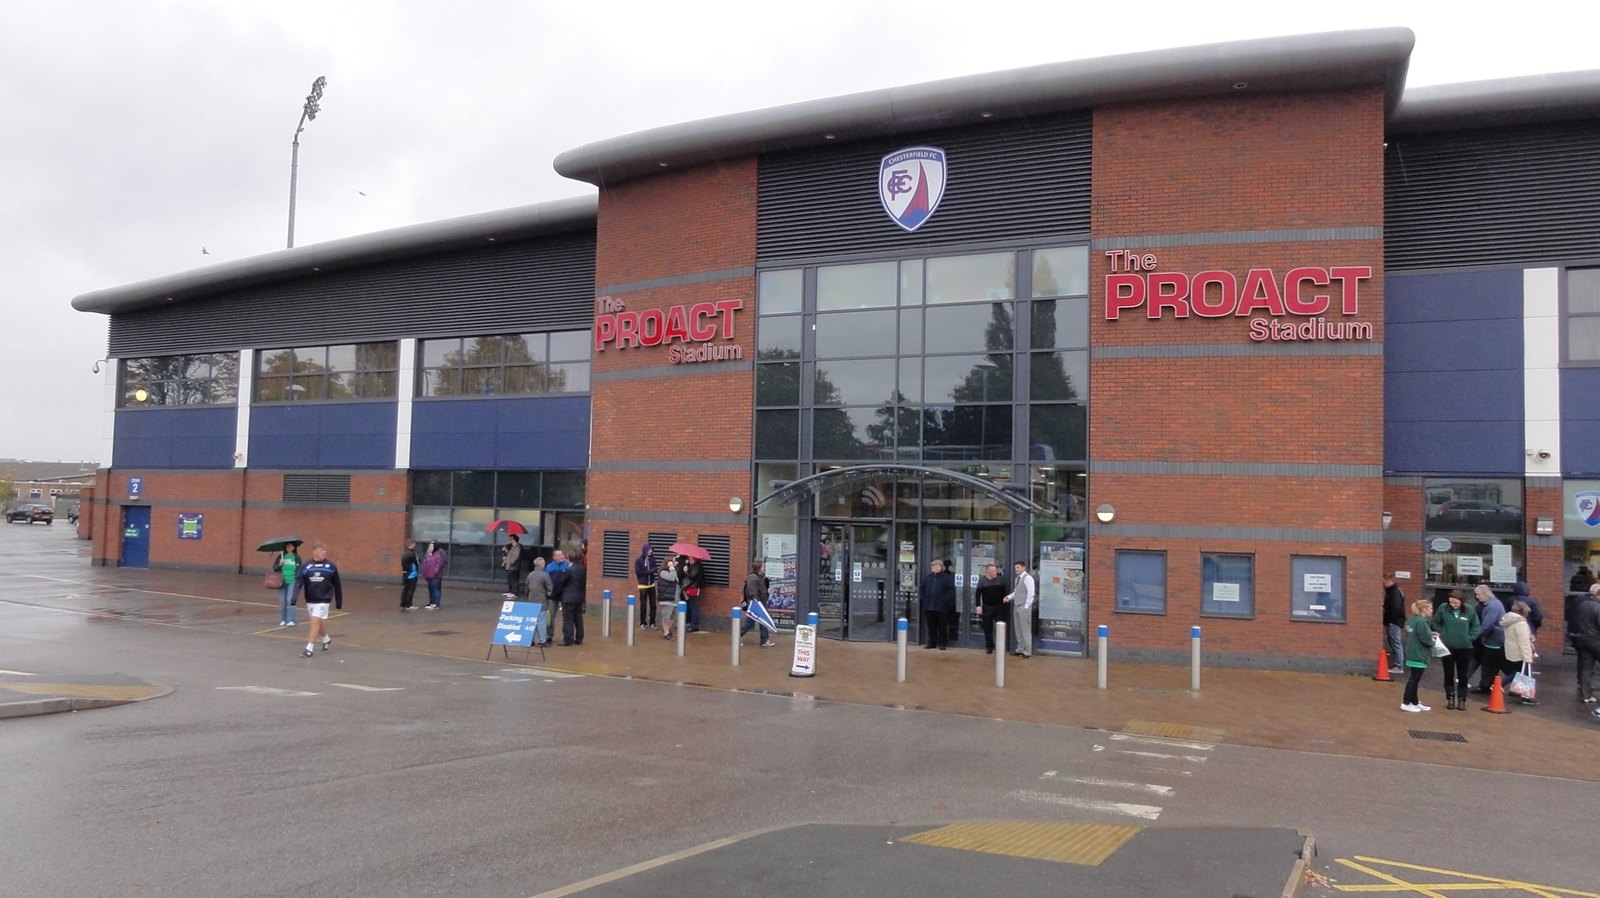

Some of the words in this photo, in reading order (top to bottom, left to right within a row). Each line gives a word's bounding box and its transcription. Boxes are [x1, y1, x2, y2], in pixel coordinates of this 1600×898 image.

[888, 151, 929, 165] CHESTERFIELD
[929, 151, 938, 160] FC
[1105, 250, 1158, 271] The
[1105, 266, 1372, 320] PROACT
[596, 295, 626, 313] The
[594, 299, 743, 351] PROACT
[1249, 317, 1373, 341] Stadium
[668, 342, 741, 365] Stadium
[132, 483, 139, 493] 2
[500, 614, 523, 623] Parking
[797, 649, 810, 657] THIS
